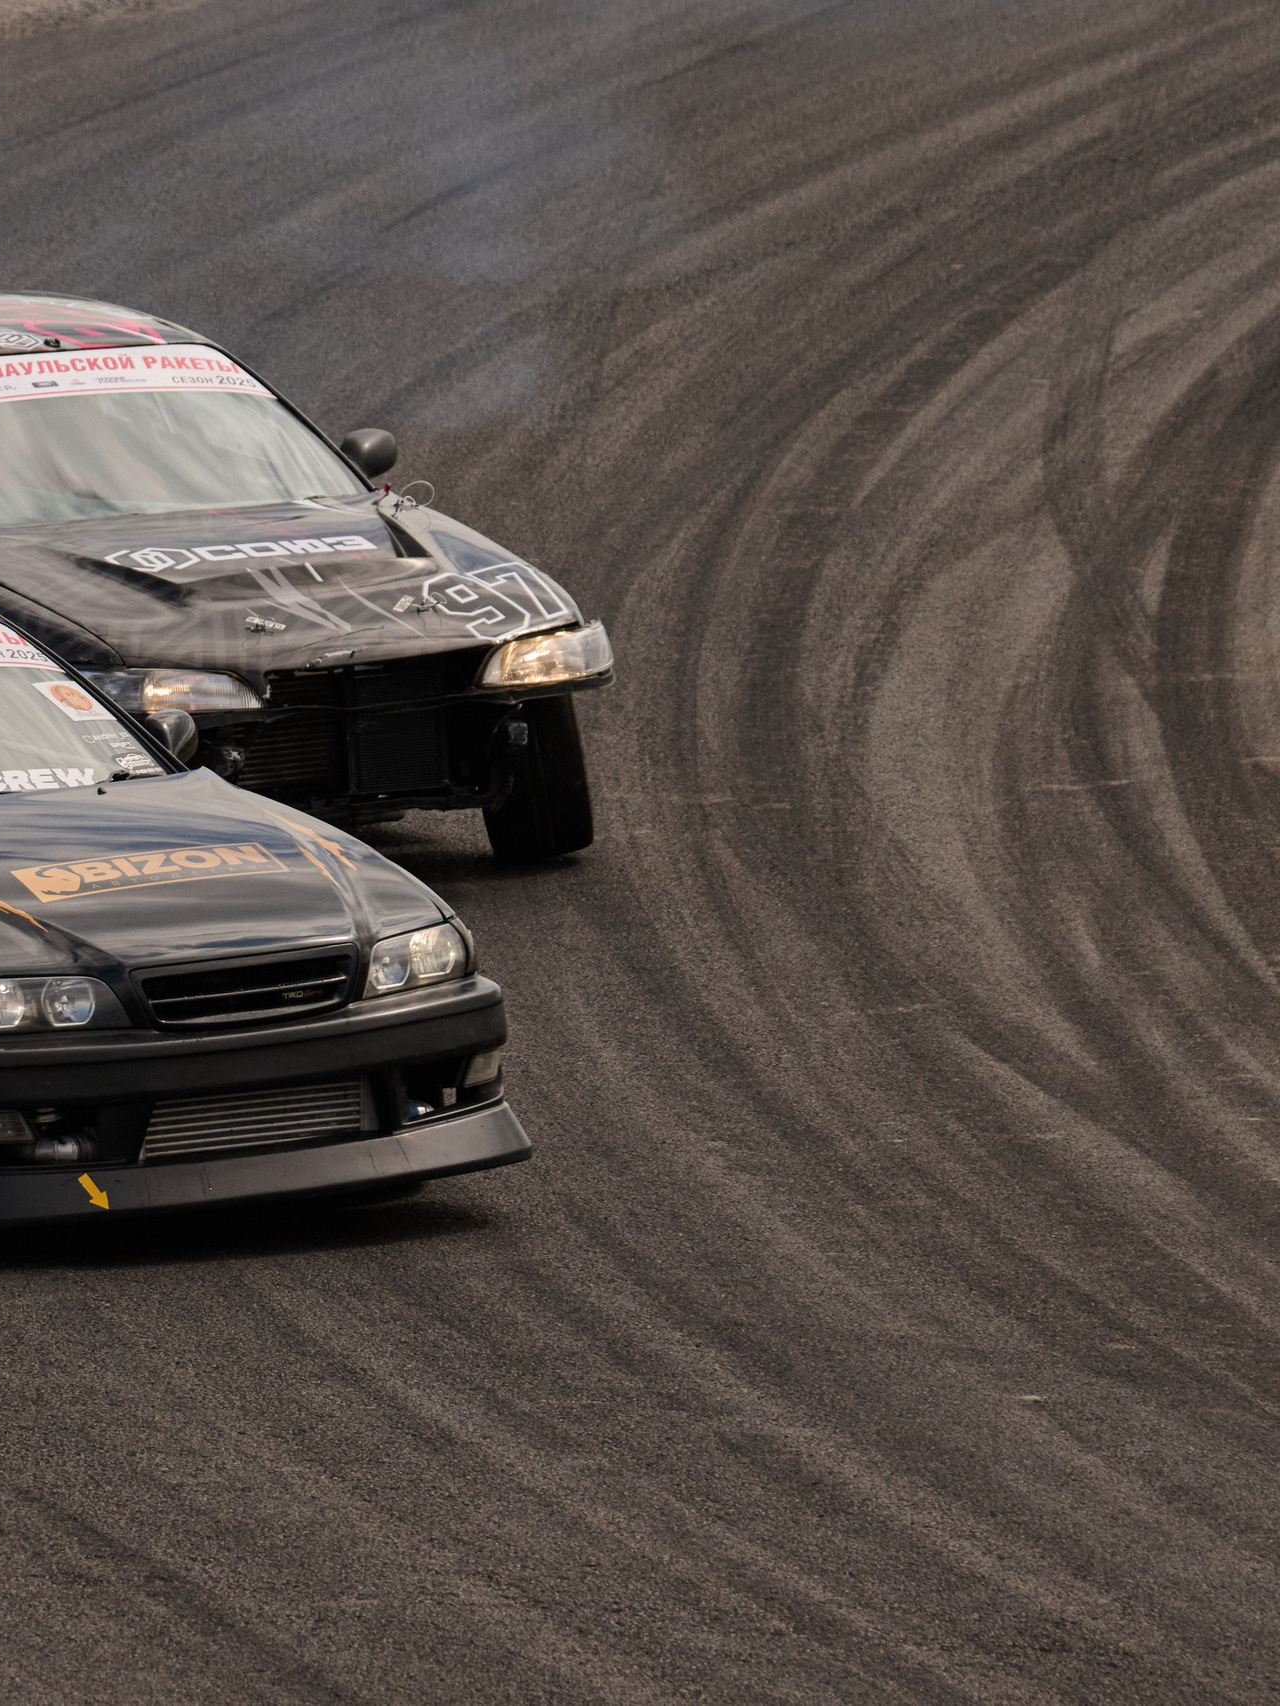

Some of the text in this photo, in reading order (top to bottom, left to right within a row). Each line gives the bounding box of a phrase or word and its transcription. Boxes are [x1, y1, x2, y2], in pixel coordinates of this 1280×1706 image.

[142, 355, 240, 374] РАКЕТЫ
[172, 375, 256, 388] СЕЗОН 2025
[422, 562, 568, 643] 97
[6, 649, 49, 663] 2025
[74, 846, 270, 883] BIZON
